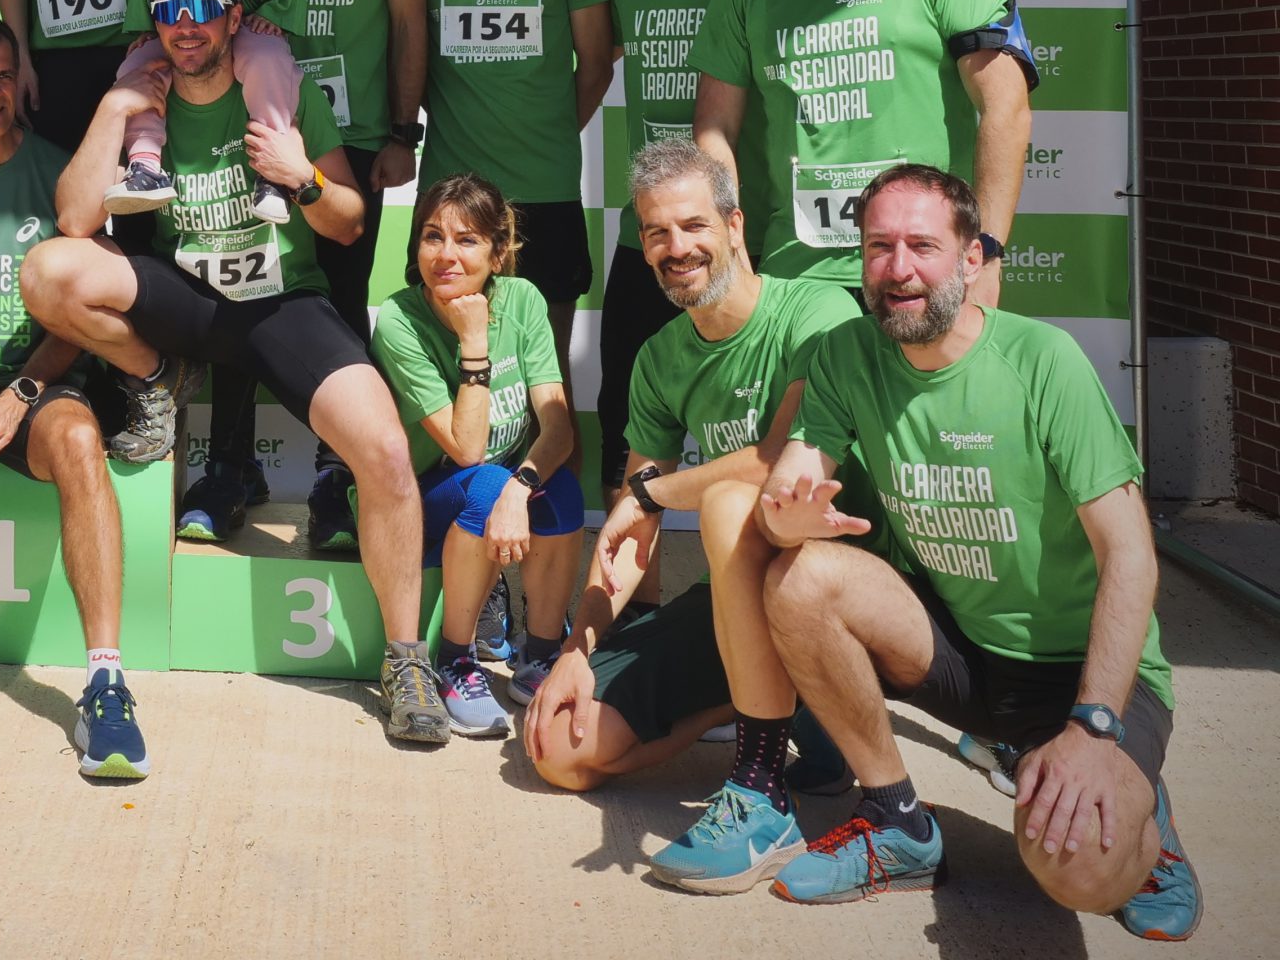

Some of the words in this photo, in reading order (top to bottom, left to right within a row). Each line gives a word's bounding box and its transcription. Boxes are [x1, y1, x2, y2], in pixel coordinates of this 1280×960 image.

[78, 17, 104, 29] SEGURIDAD
[458, 12, 530, 41] 154
[634, 10, 644, 37] V
[776, 29, 788, 58] V
[794, 16, 879, 57] CARRERA
[450, 45, 472, 54] CARRERA
[472, 45, 482, 54] POR
[482, 45, 490, 54] LA
[489, 45, 516, 54] SEGURIDAD
[516, 45, 539, 53] LABORAL
[777, 63, 786, 80] LA
[791, 49, 895, 91] SEGURIDAD
[797, 88, 872, 124] LABORAL
[652, 127, 692, 140] Schneid
[177, 164, 247, 202] CARRERA
[815, 168, 880, 181] Schneider
[1027, 167, 1062, 179] tric
[814, 196, 860, 228] 14
[198, 231, 256, 246] Schneider
[223, 241, 255, 252] Electric
[195, 252, 267, 286] 152
[1001, 246, 1064, 268] eider
[229, 287, 256, 299] SEGURIDAD
[257, 284, 280, 295] LABORAL
[703, 423, 713, 454] V
[940, 431, 994, 443] Schneider
[962, 442, 994, 450] Electric
[901, 463, 994, 502] CARRERA
[900, 504, 1018, 543] SEGURIDAD
[908, 537, 998, 582] LABORAL
[282, 577, 335, 658] 3
